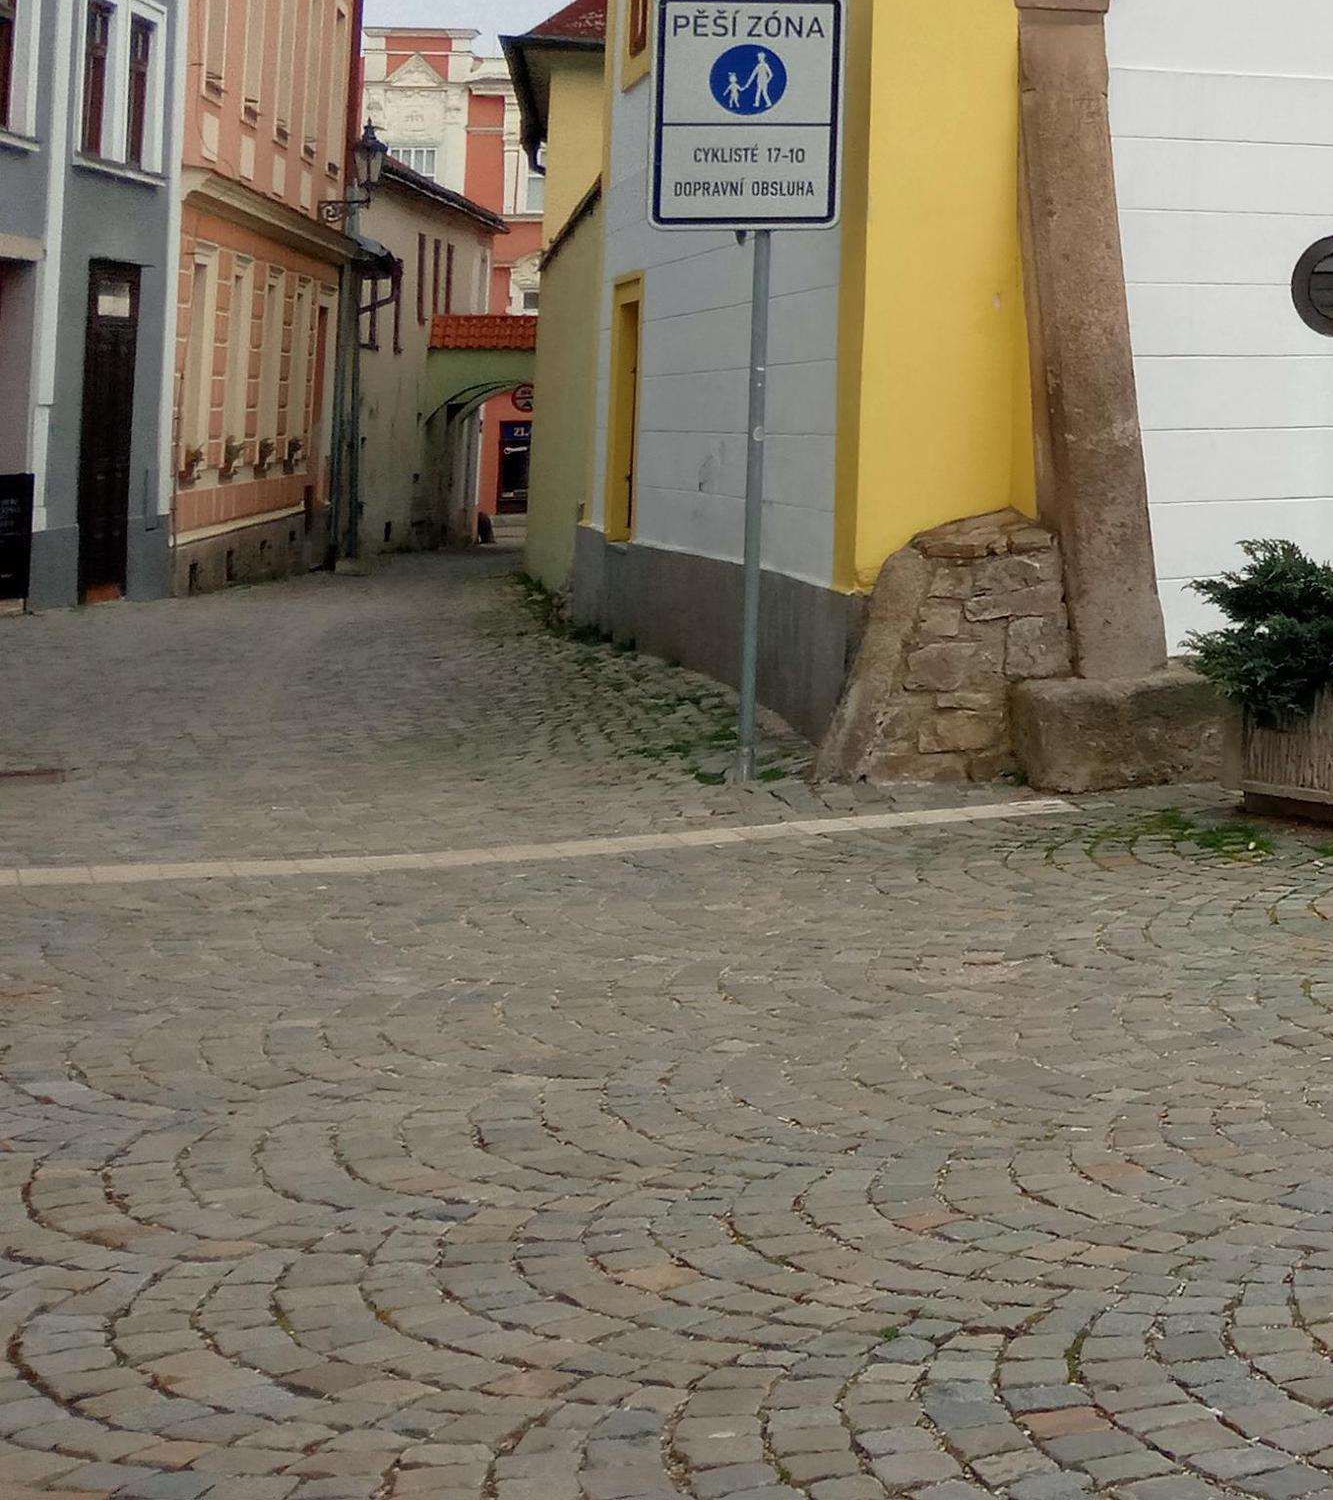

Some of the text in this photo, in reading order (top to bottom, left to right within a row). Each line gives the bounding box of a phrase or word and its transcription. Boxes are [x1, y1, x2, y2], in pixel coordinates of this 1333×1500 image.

[672, 9, 825, 38] PĚŠÍ ZÓNA
[693, 144, 806, 164] CYKLISTÉ 17-10
[674, 177, 815, 197] DOPRAVNÍ OBSLUHA
